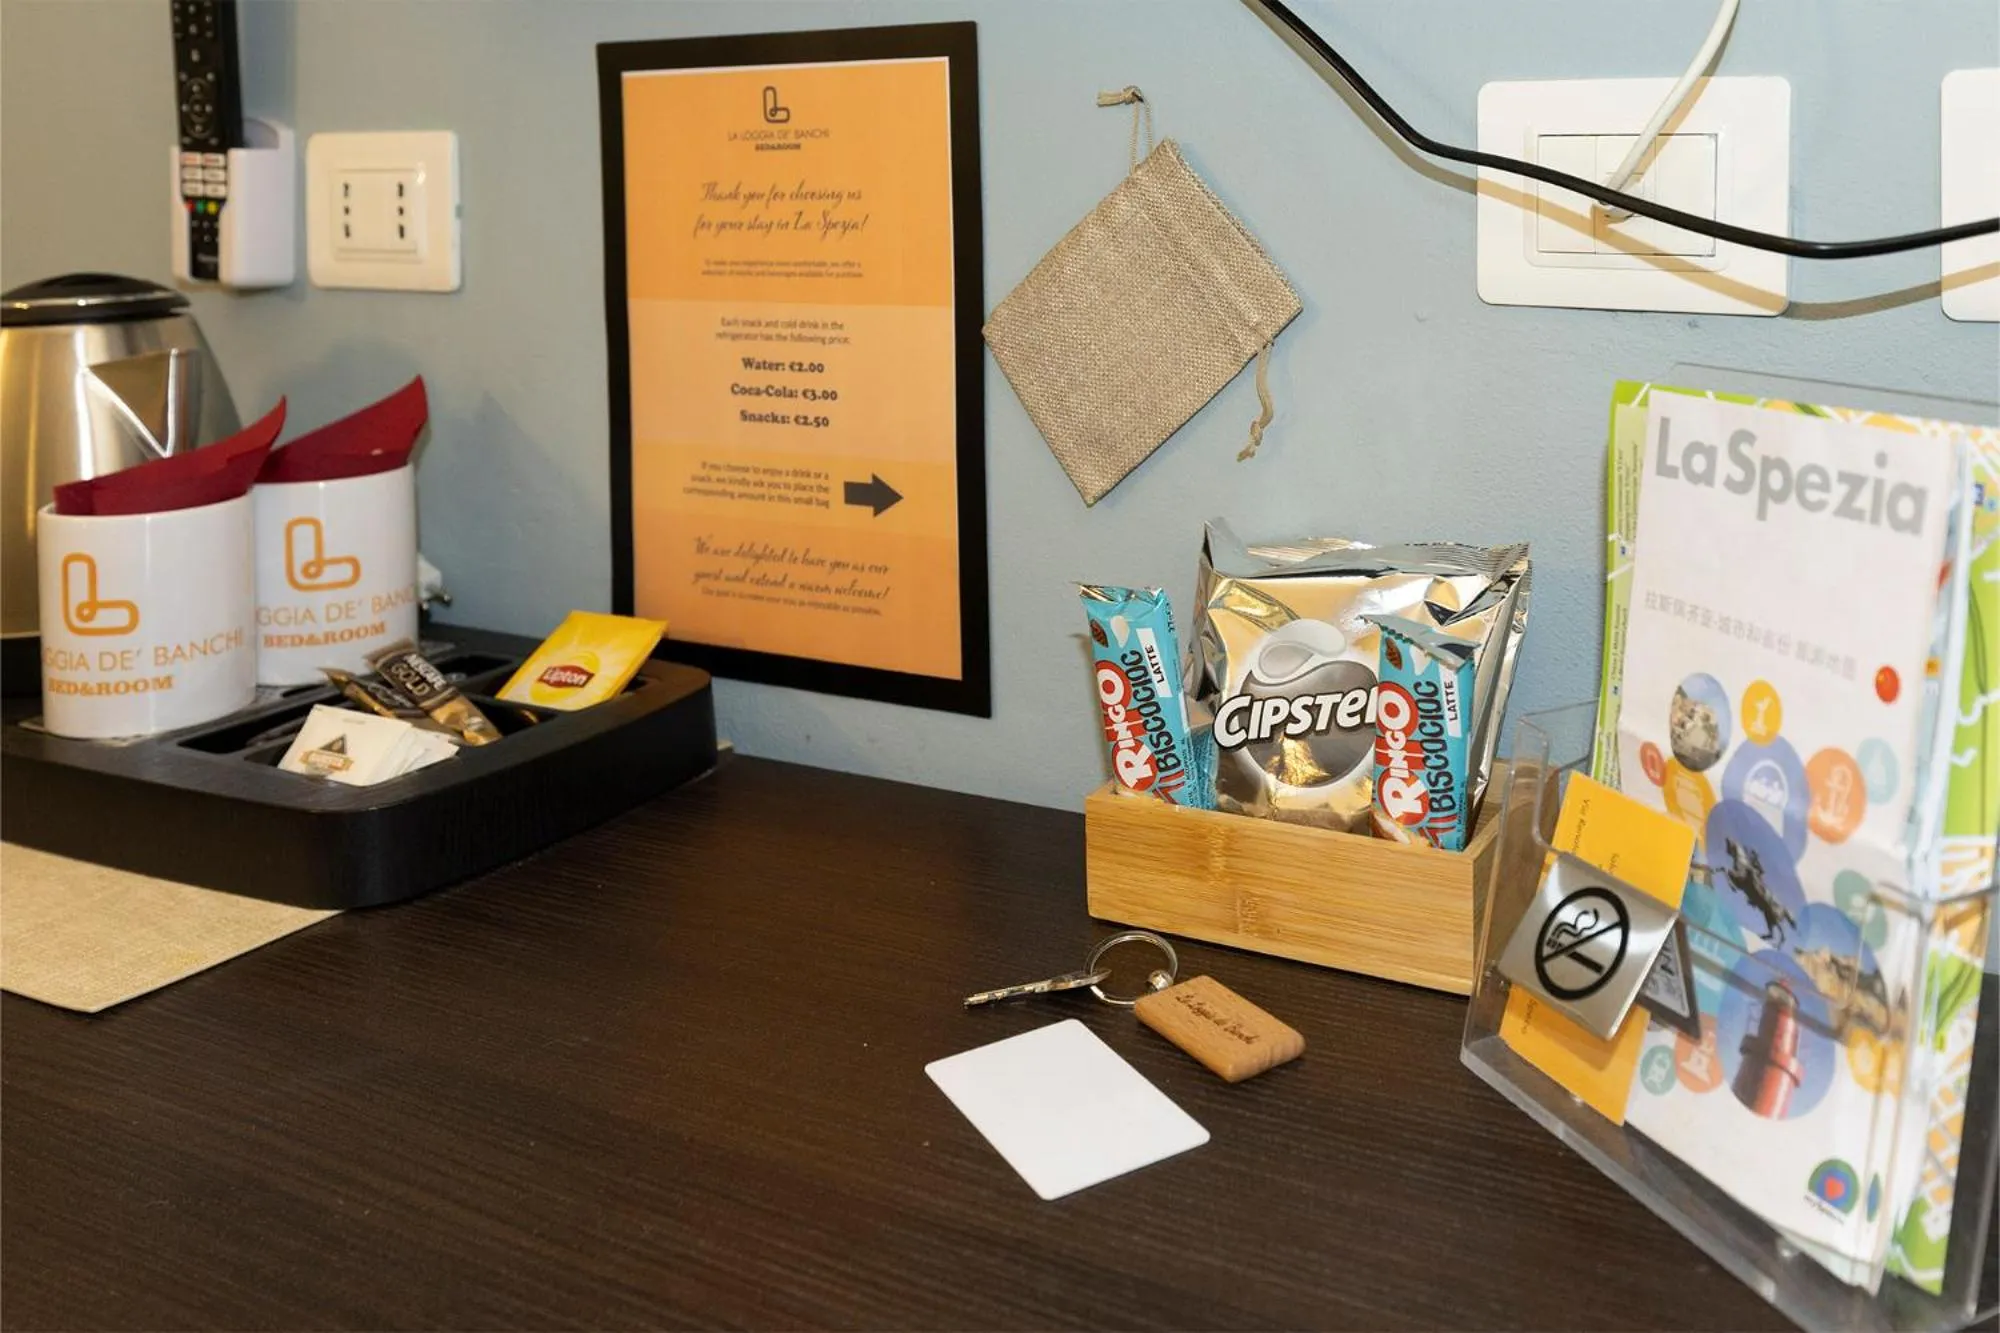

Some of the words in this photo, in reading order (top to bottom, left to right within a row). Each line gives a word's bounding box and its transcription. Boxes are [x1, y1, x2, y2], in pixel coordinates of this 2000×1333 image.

[702, 180, 742, 201] Thank
[742, 190, 767, 210] you
[765, 183, 785, 209] for
[790, 179, 843, 209] choosing
[847, 189, 862, 201] us
[693, 214, 712, 239] for
[715, 219, 743, 238] your
[747, 214, 775, 238] stay
[777, 217, 789, 230] in
[794, 211, 811, 230] La
[742, 357, 785, 371] Water:
[789, 361, 825, 373] €2.00
[731, 383, 798, 399] Coca-Cola:
[802, 388, 838, 401] €3.00
[740, 410, 790, 425] Snacks:
[794, 414, 829, 428] €2.50
[734, 542, 785, 566] delighted
[801, 548, 827, 567] have
[829, 558, 850, 575] you
[725, 569, 749, 583] and
[750, 573, 788, 588] extend
[834, 578, 890, 600] welcome!
[153, 627, 243, 667] BANCHI
[263, 621, 385, 648] BED&ROOM
[391, 662, 430, 696] GOLD
[543, 667, 588, 685] Lipton
[1145, 644, 1165, 684] LATTE
[48, 675, 173, 697] BED&ROOM
[1443, 680, 1458, 721] LATTE
[1121, 649, 1182, 773] BISCOCIOC
[1096, 668, 1154, 789] RINGO
[1378, 689, 1428, 819] RINGO
[1413, 680, 1457, 813] BISCOCIOC
